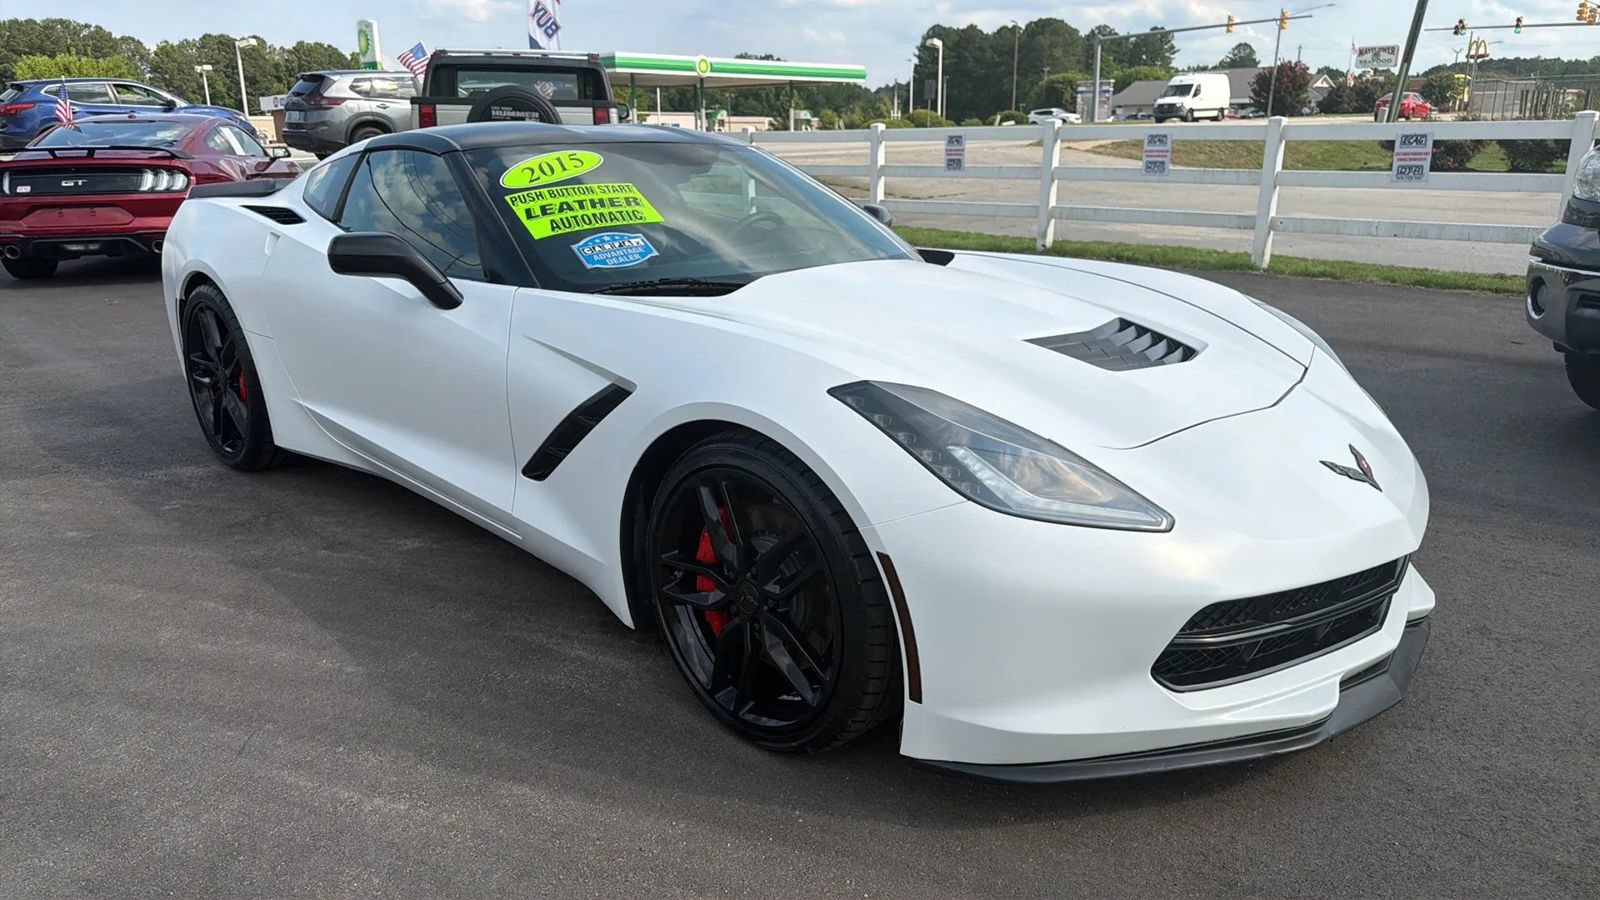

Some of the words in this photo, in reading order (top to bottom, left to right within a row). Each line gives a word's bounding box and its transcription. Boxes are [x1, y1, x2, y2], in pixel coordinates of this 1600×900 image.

[491, 110, 540, 118] HUMMER
[521, 153, 585, 184] 2015
[510, 190, 545, 206] PUSH
[549, 185, 595, 199] BUTTON
[599, 184, 634, 195] START
[524, 197, 642, 220] LEATHER
[550, 210, 646, 232] AUTOMATIC
[582, 239, 643, 255] CARFAX
[593, 246, 646, 261] ADVANTAGE
[606, 254, 641, 265] DEALER
